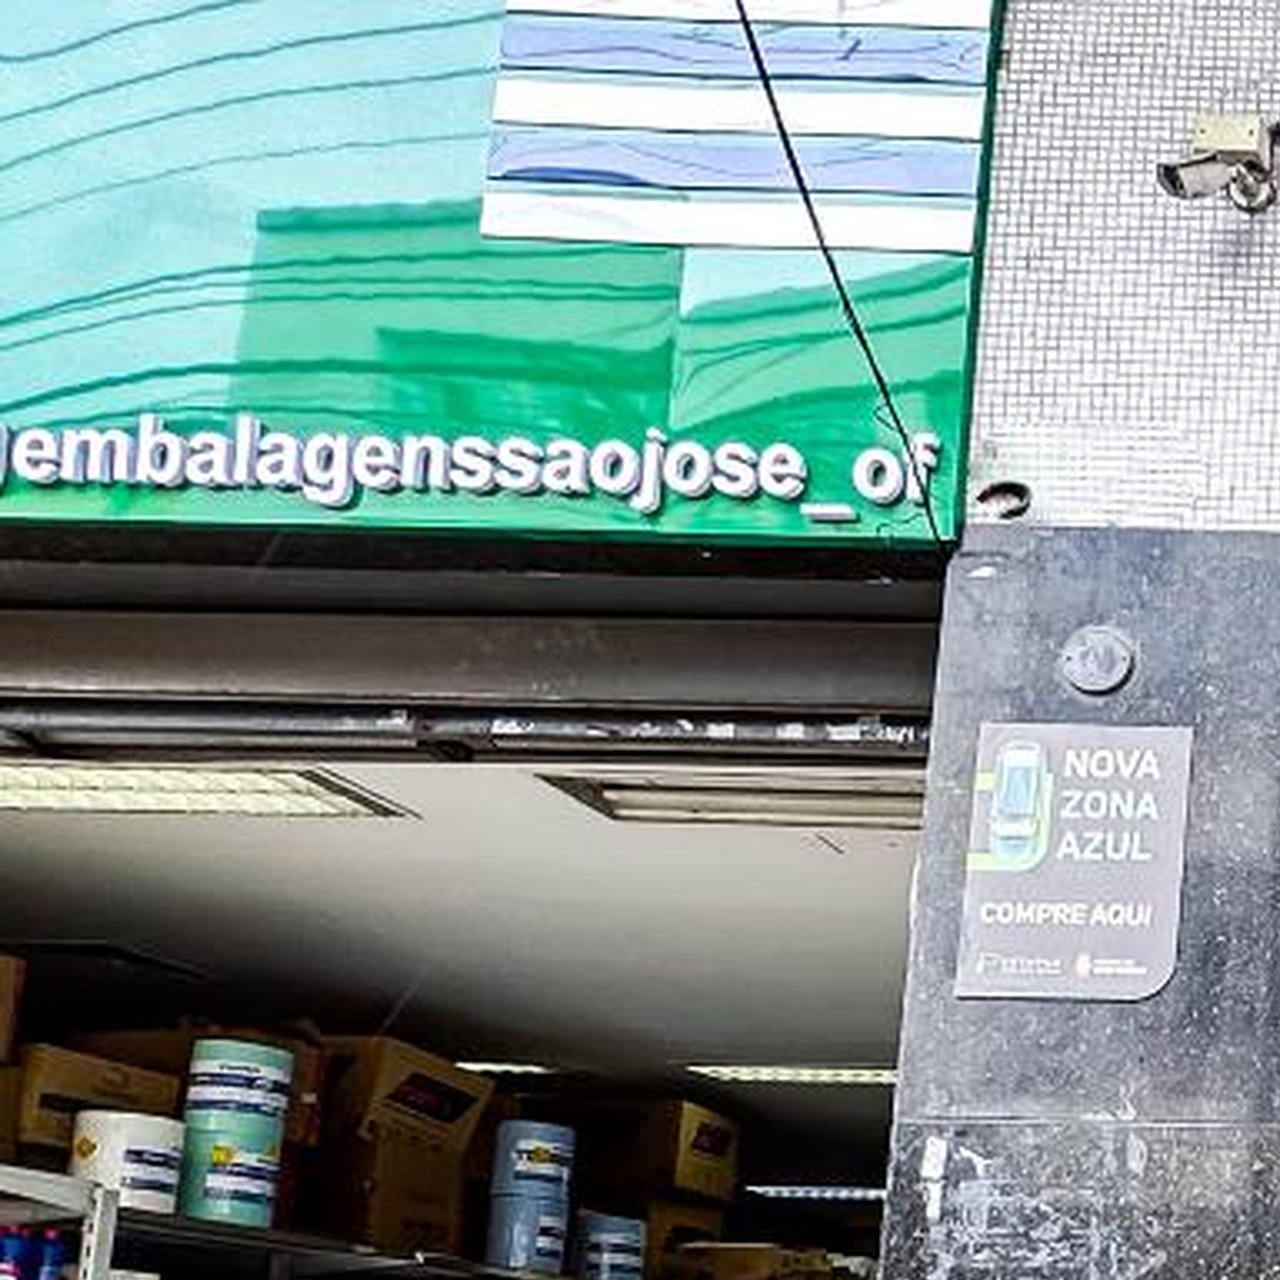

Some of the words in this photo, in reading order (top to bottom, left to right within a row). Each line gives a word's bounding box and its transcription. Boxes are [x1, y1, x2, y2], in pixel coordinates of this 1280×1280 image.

[0, 412, 942, 519] embalagenssaojose_of
[1062, 748, 1160, 779] NOVA
[1059, 790, 1159, 820] ZONA
[1056, 831, 1152, 861] AZUL
[979, 902, 1086, 925] COMPRE
[1089, 902, 1153, 928] AQUI
